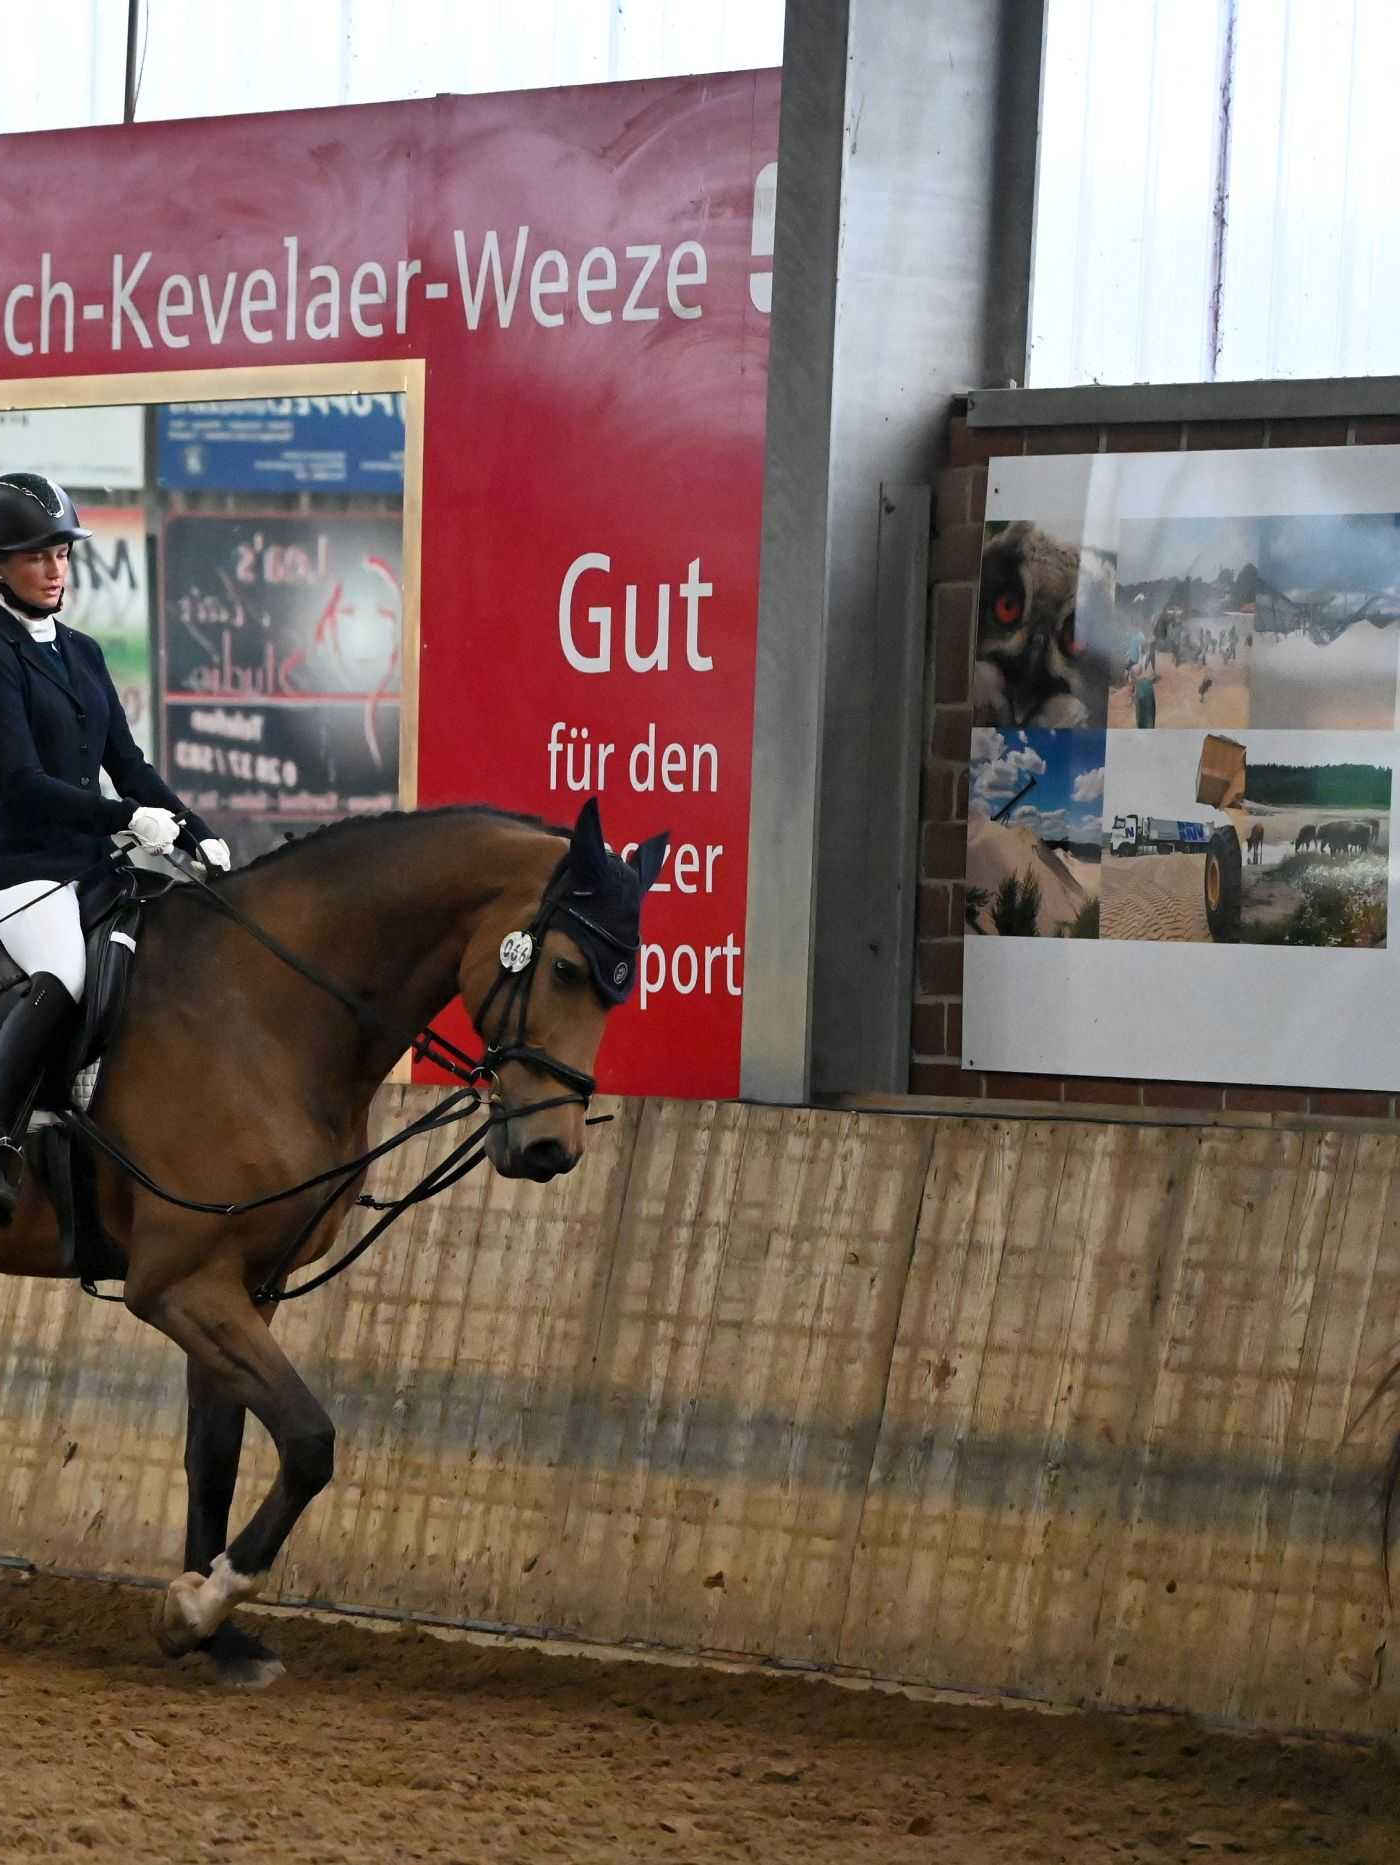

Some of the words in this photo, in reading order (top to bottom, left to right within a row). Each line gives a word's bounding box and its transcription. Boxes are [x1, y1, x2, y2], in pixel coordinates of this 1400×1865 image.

[557, 552, 714, 674] Gut
[547, 722, 615, 791] für
[628, 723, 719, 793] den
[640, 932, 743, 1010] port
